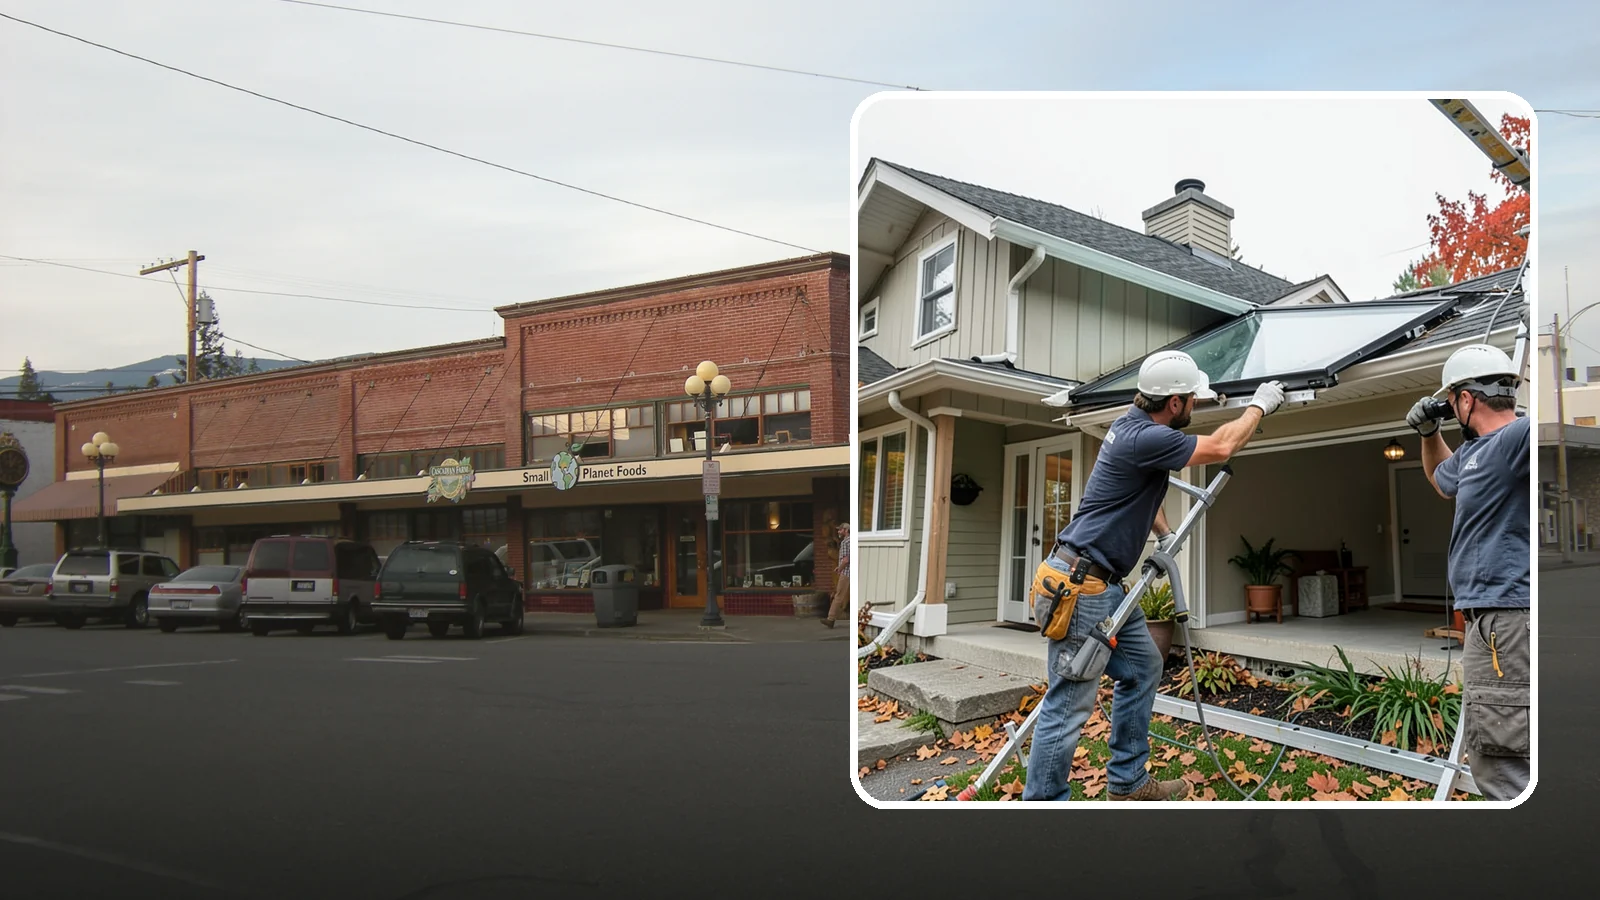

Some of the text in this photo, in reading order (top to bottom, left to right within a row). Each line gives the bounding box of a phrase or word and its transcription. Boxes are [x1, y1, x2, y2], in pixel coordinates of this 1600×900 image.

[523, 464, 647, 482] Small Planet Foods
